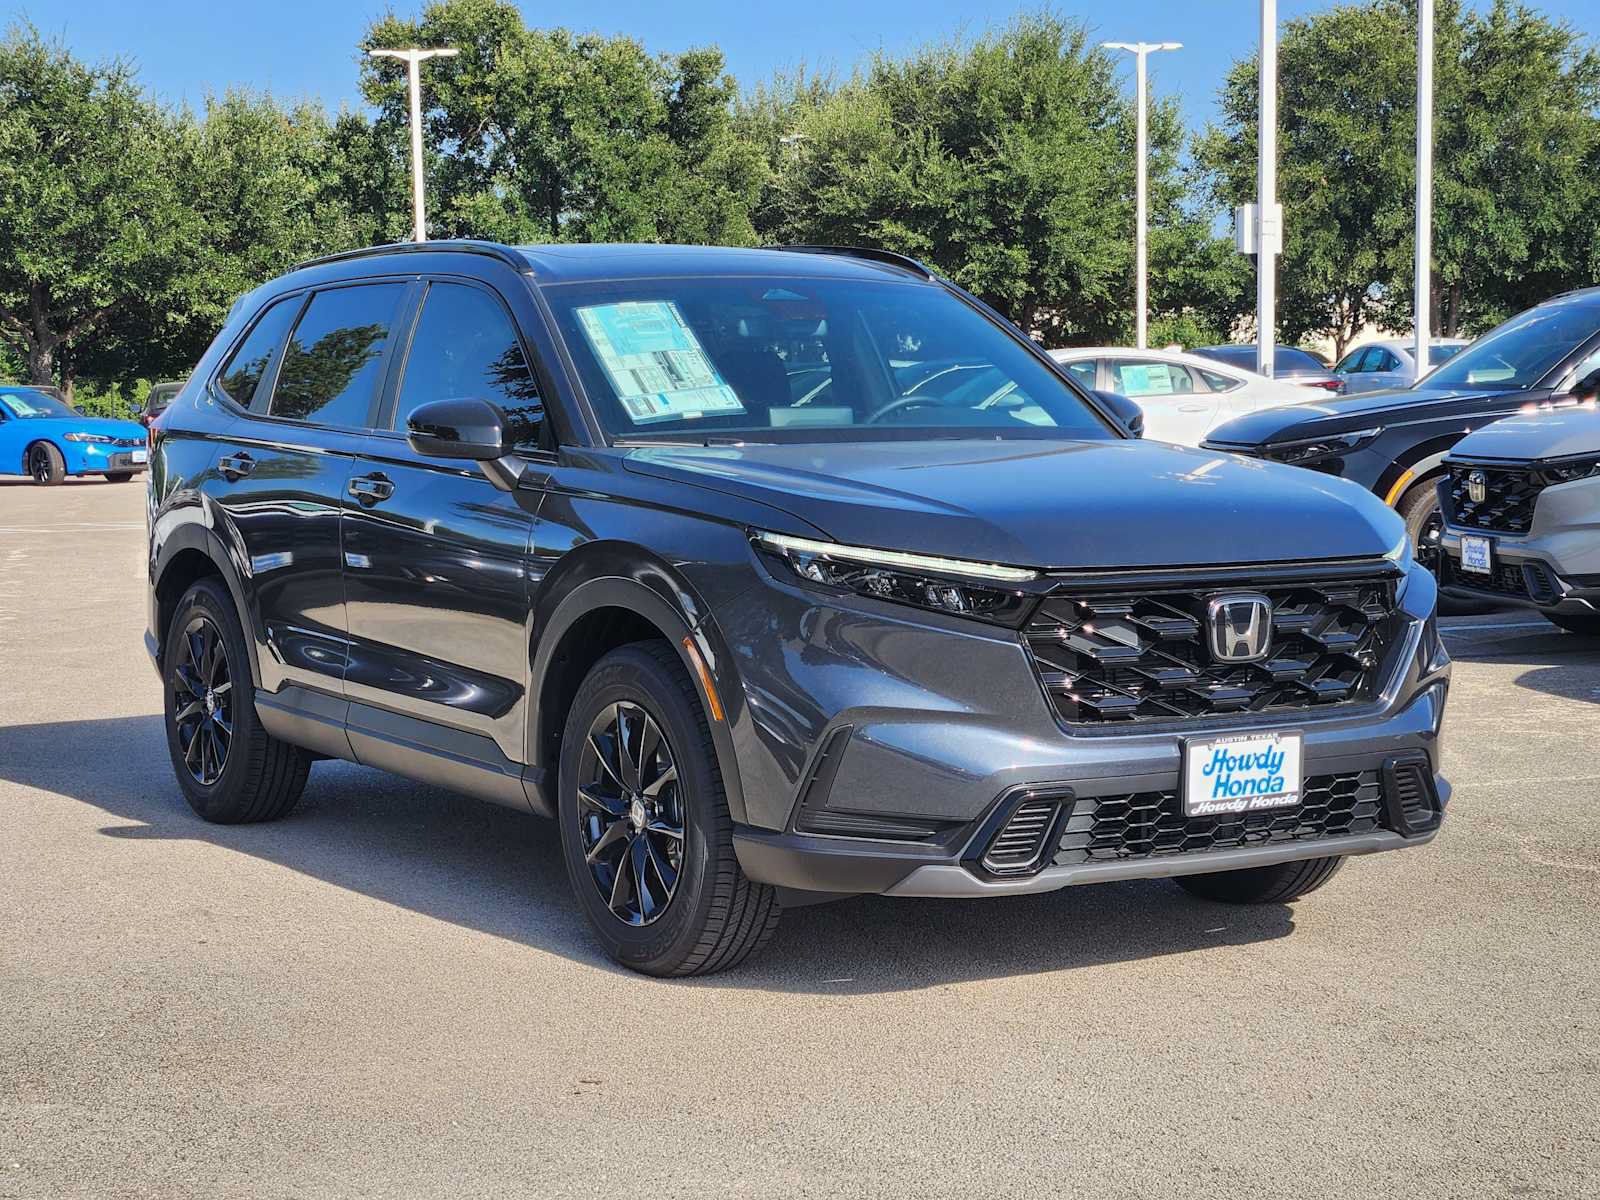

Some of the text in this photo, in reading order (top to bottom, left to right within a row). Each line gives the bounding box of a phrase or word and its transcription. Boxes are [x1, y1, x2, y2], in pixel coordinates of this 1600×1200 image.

[1203, 745, 1285, 776] Howdy
[1212, 774, 1285, 798] Honda
[1191, 793, 1298, 814] Howdy Honda
